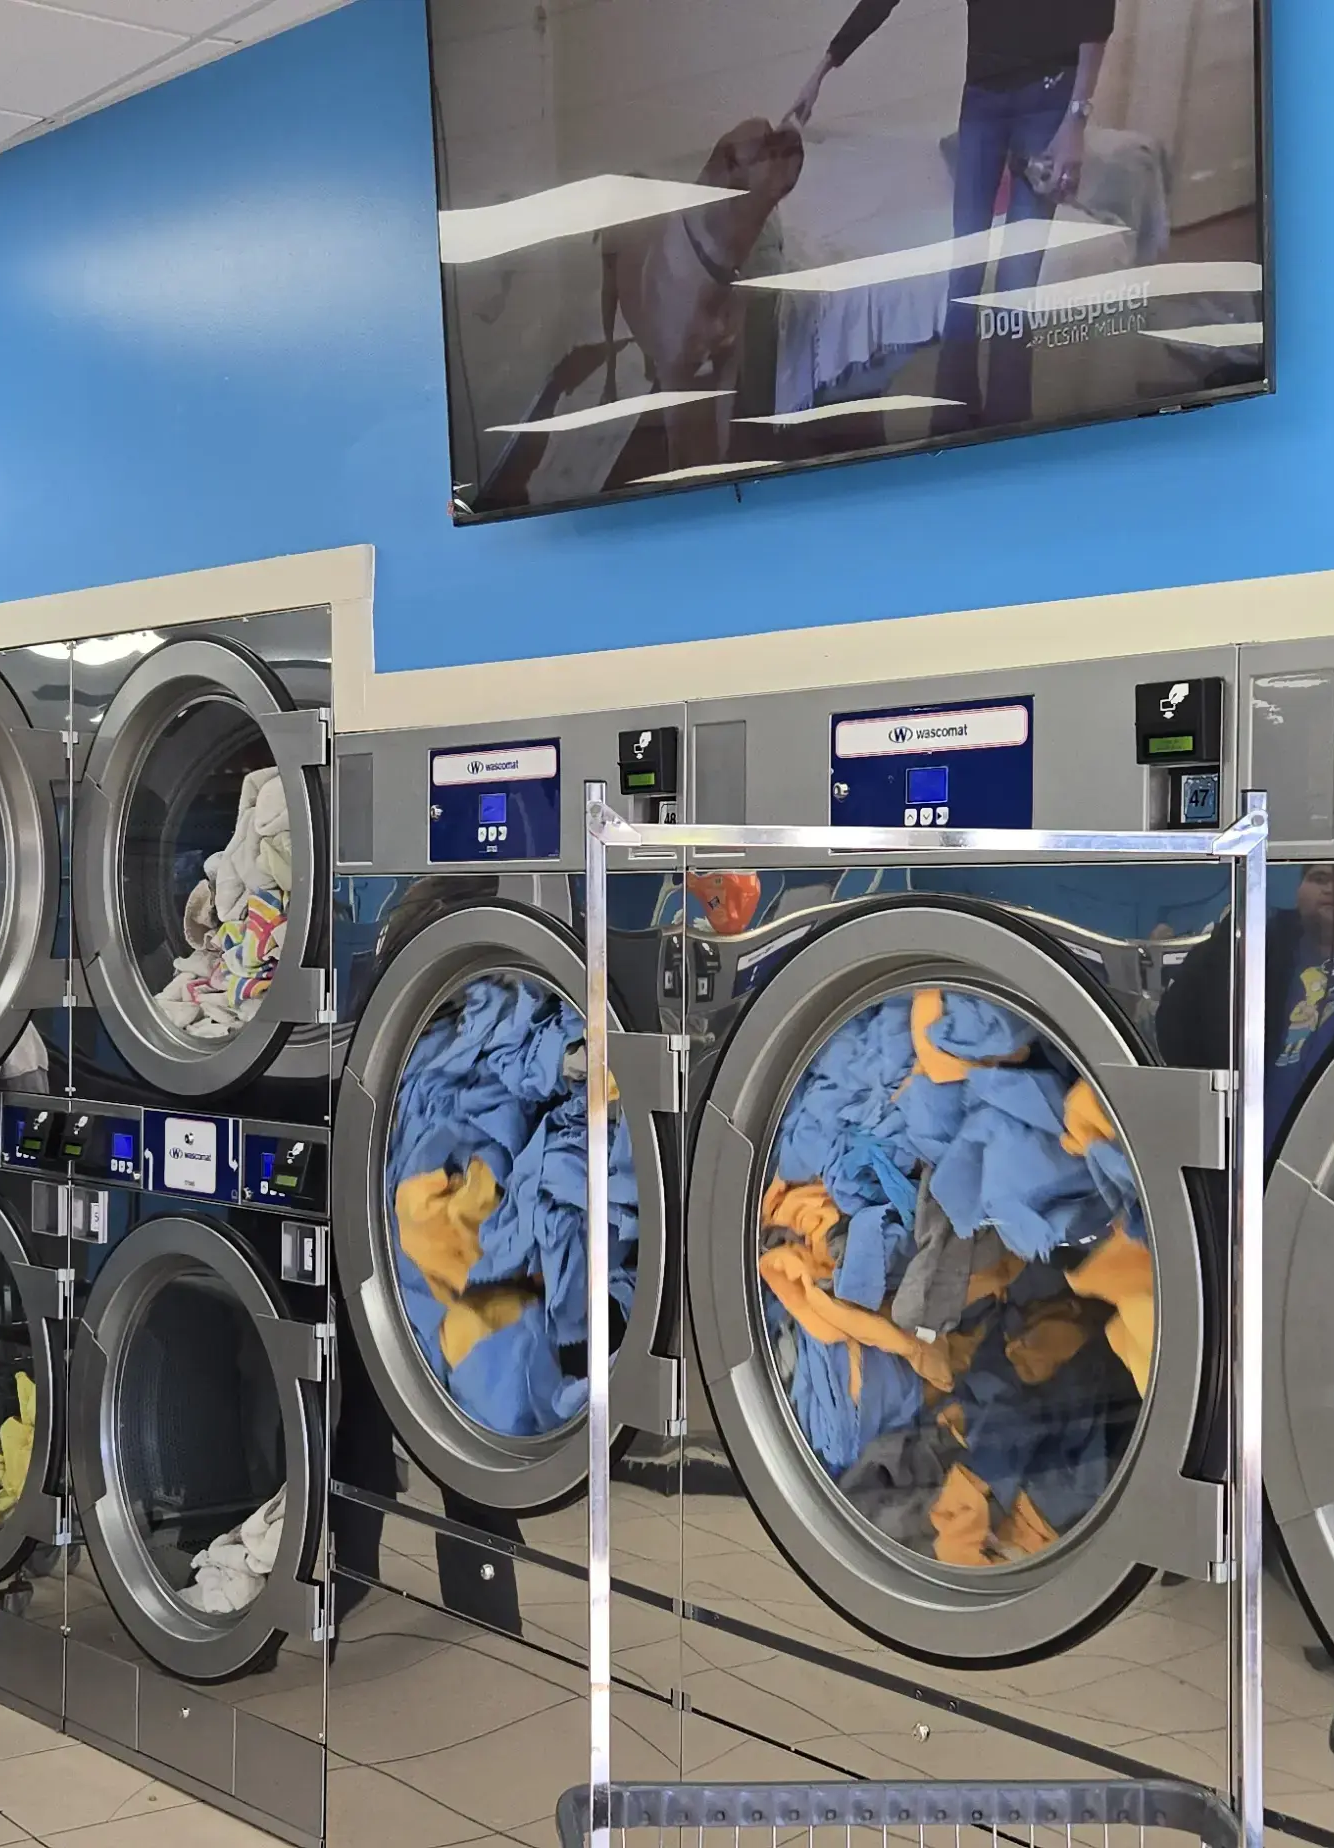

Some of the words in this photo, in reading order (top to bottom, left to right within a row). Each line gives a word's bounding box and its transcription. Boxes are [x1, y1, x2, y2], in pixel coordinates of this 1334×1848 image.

[980, 308, 1023, 340] Dog
[916, 723, 968, 740] wascomat
[485, 760, 519, 772] wascomat
[1188, 788, 1210, 807] 47
[184, 1152, 212, 1162] wascomat
